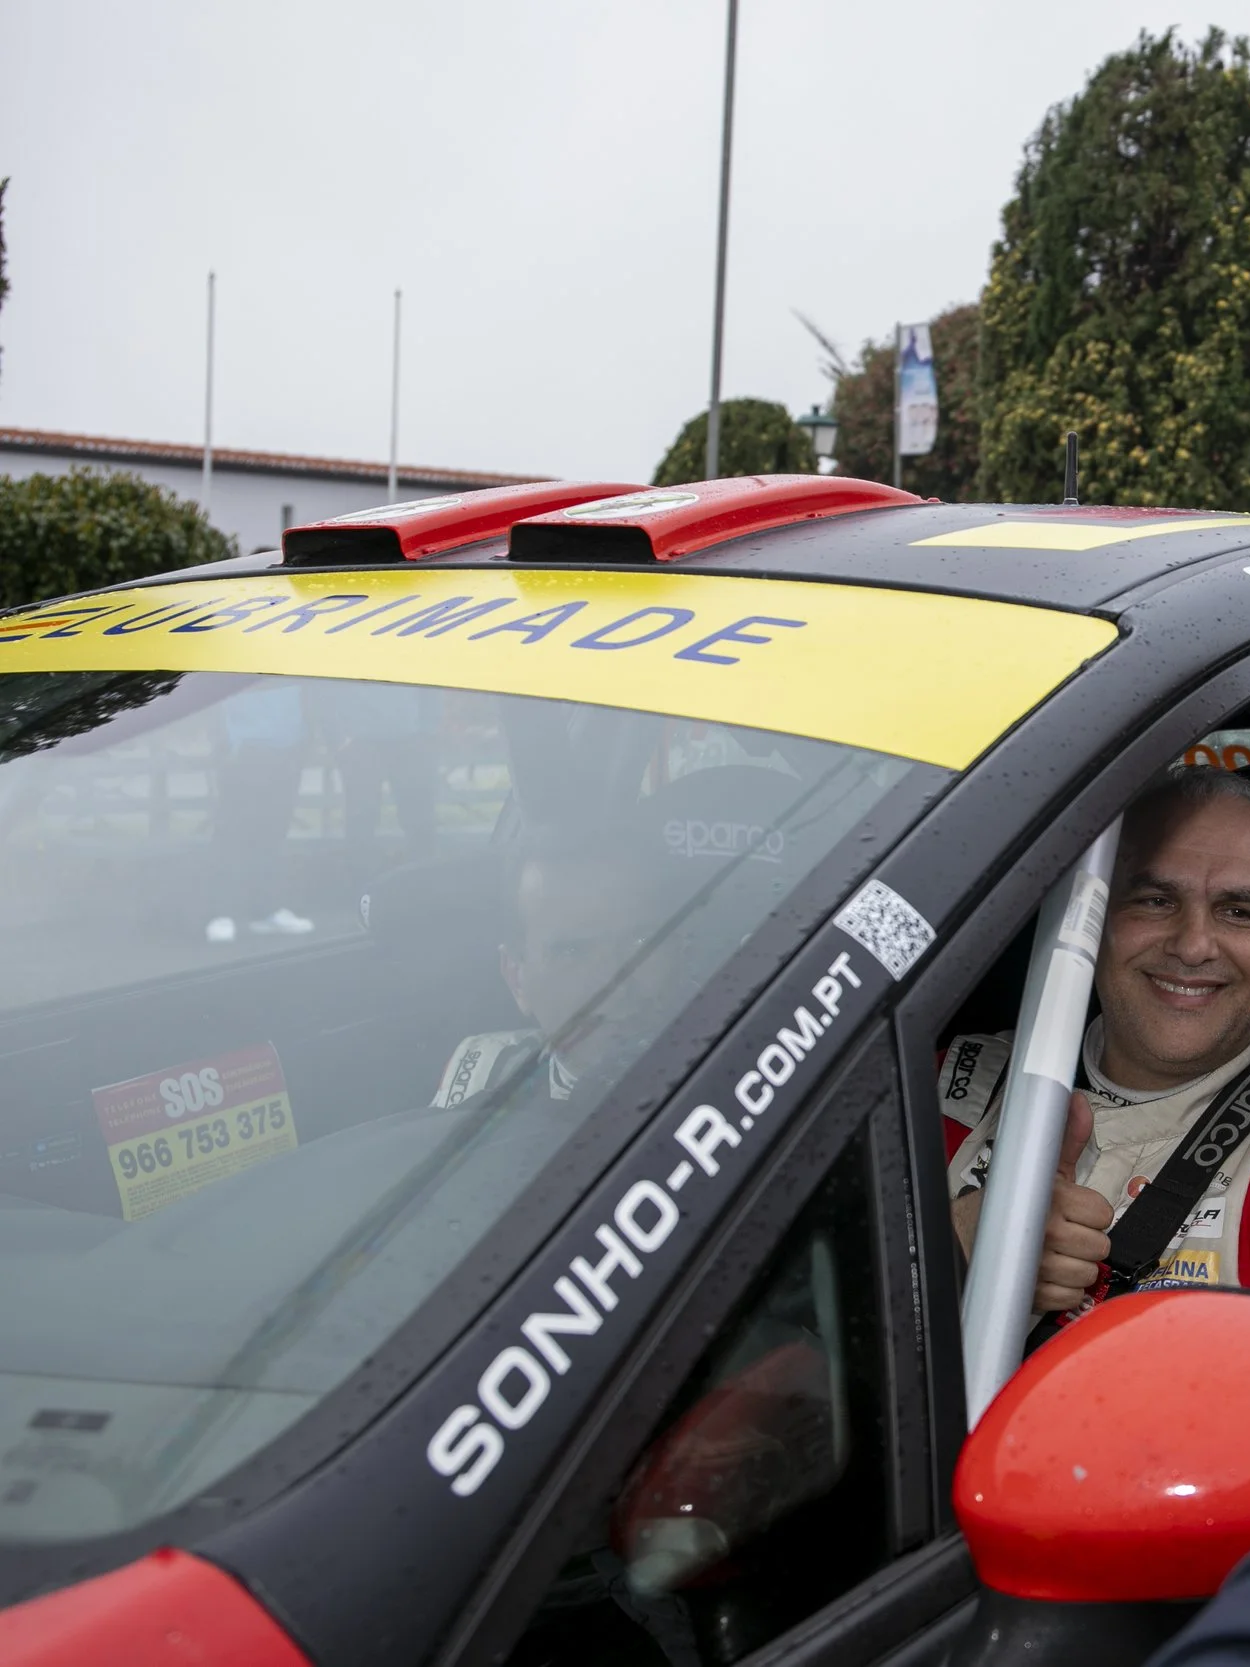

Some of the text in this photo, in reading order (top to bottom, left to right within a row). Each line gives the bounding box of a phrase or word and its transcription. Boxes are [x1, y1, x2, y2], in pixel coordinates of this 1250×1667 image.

[39, 595, 807, 665] LUBRIMADE
[159, 1067, 224, 1118] SOS
[947, 1040, 984, 1100] sparco
[118, 1138, 173, 1180] 966
[178, 1118, 231, 1160] 753
[236, 1099, 286, 1141] 375
[427, 951, 862, 1496] SONHO-R.COM.PT
